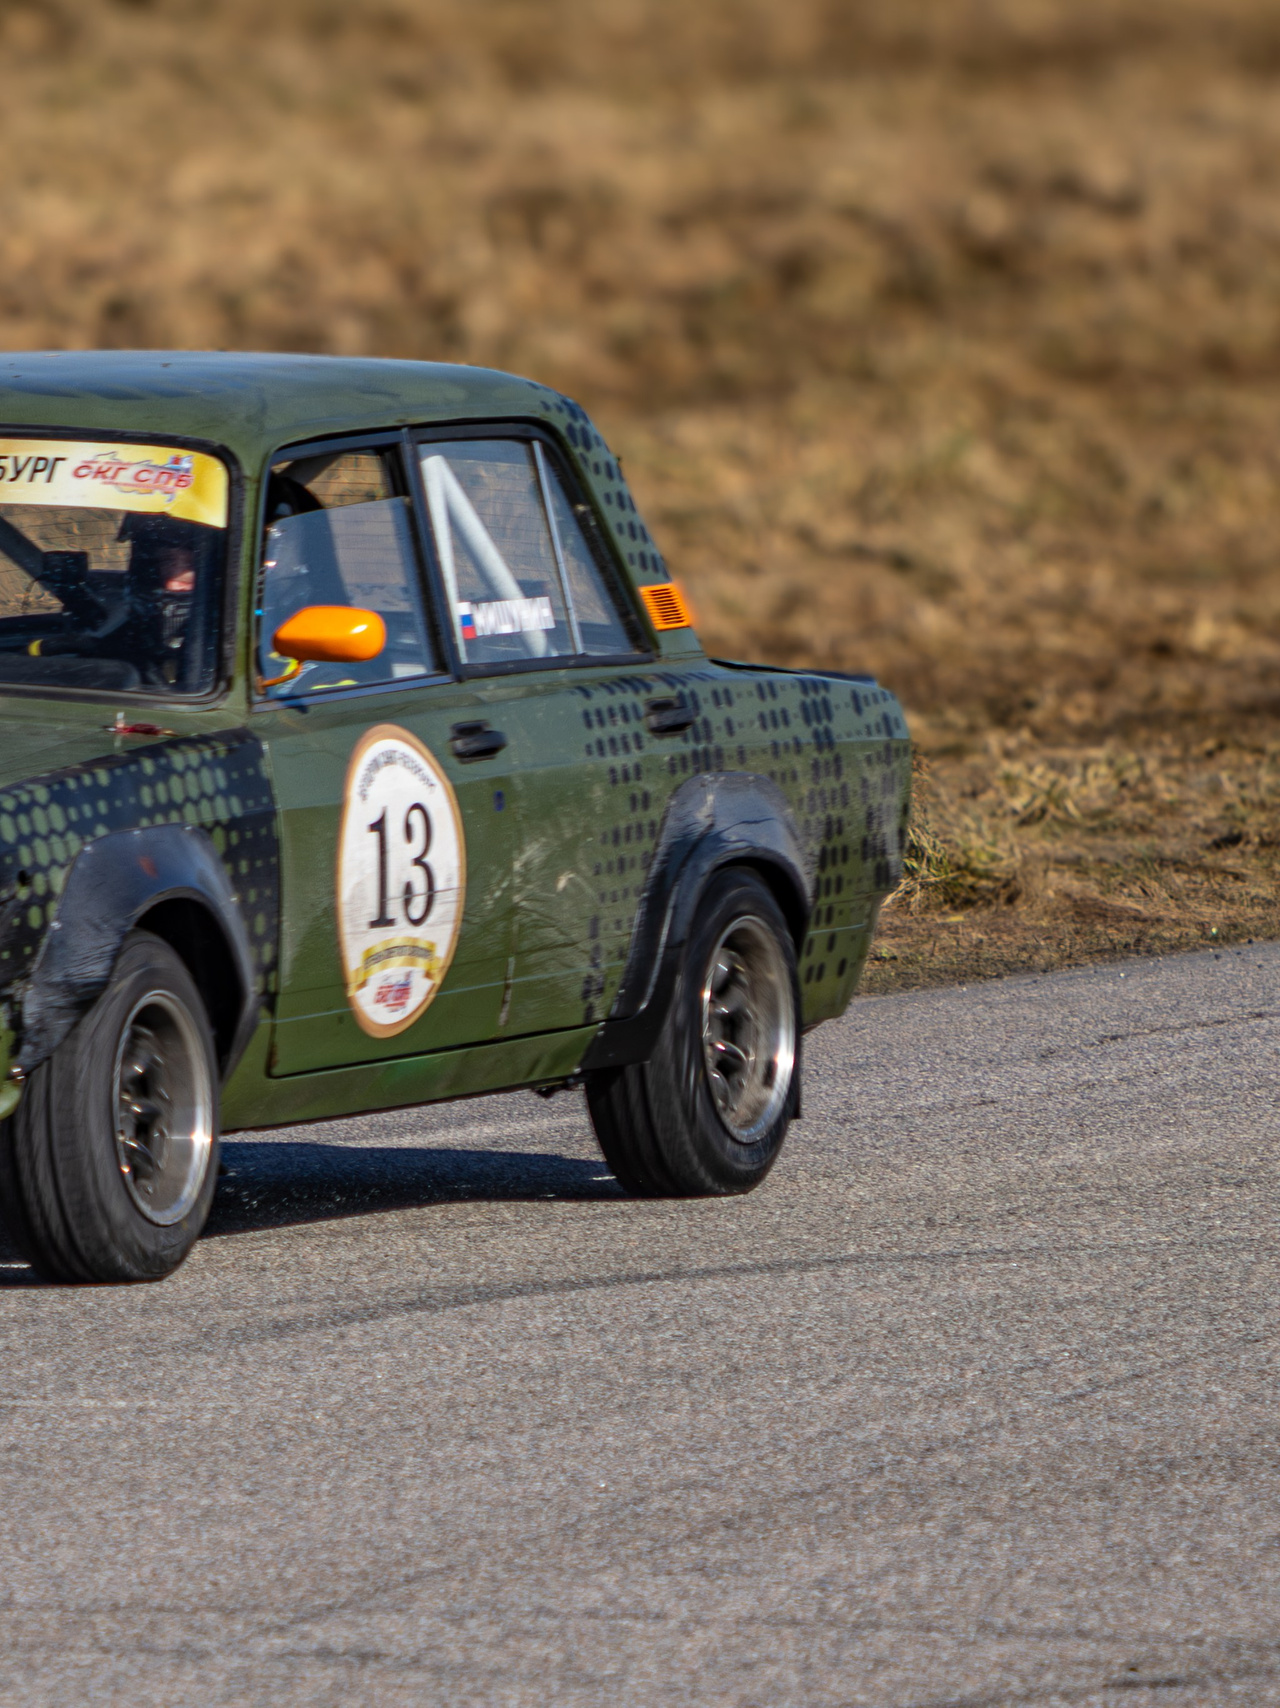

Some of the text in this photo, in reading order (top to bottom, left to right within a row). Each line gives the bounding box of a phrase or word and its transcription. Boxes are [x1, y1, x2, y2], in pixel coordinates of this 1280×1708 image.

[72, 464, 195, 488] СКГ СПБ
[367, 803, 435, 929] 13
